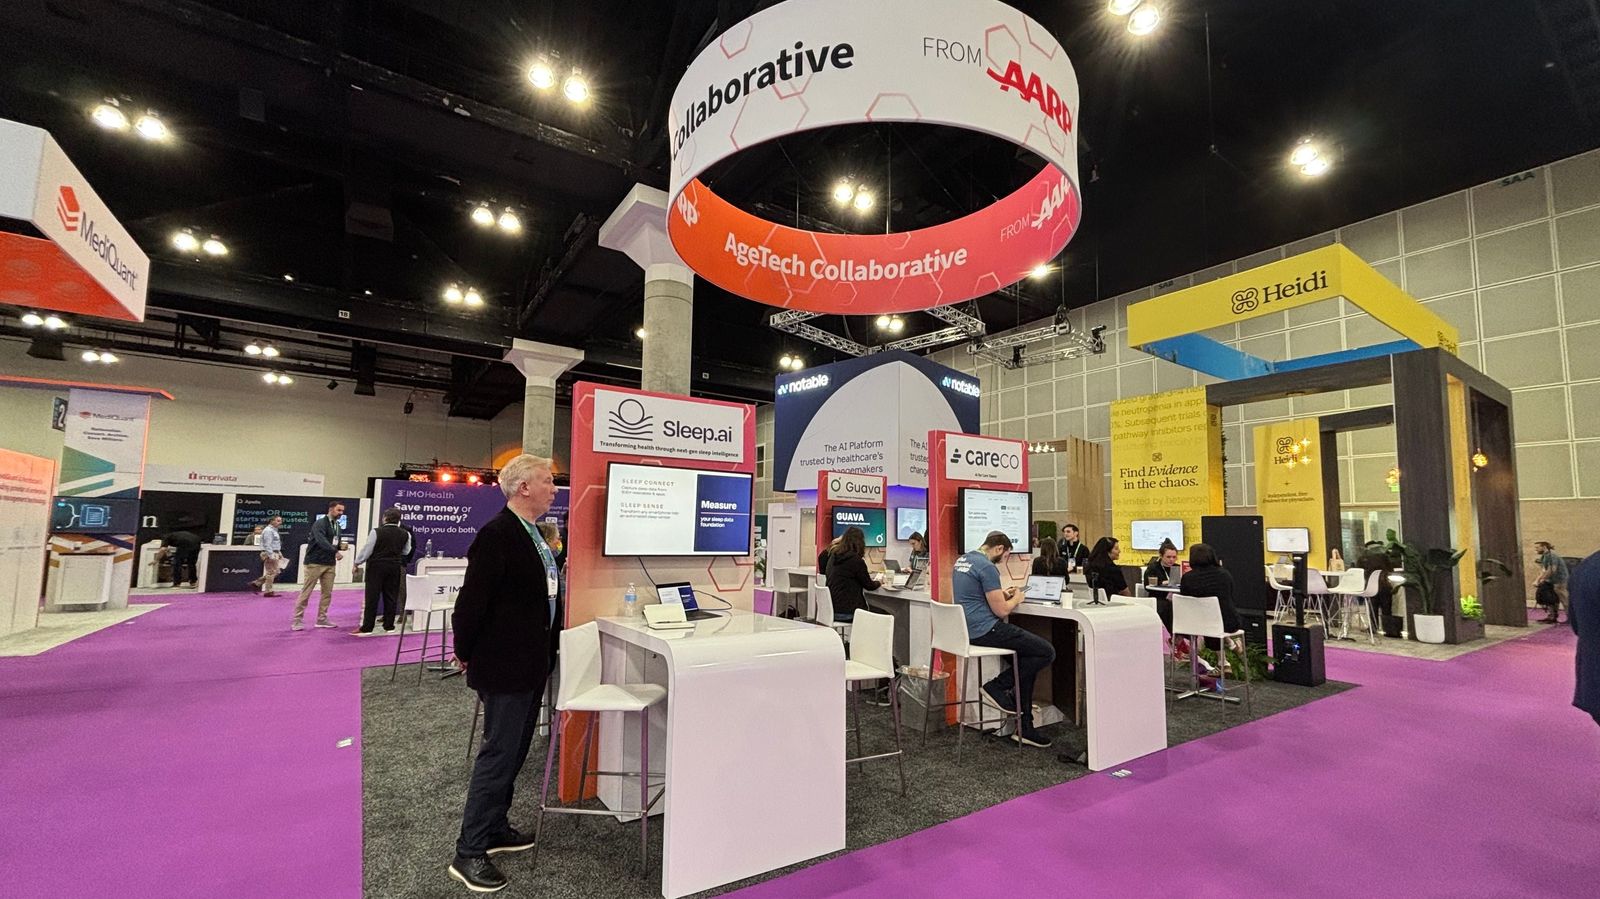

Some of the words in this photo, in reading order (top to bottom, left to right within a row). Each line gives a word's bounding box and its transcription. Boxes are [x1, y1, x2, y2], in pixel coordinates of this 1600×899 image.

[673, 41, 854, 161] Collaborative
[923, 37, 981, 67] FROM
[986, 60, 1072, 135] AARP
[80, 212, 136, 290] MediQuant
[723, 232, 805, 276] AgeTech
[810, 248, 967, 281] Collaborative
[1001, 213, 1030, 242] FROM
[1263, 270, 1328, 304] Heidi
[788, 374, 829, 393] notable
[950, 378, 980, 397] notable
[1124, 414, 1176, 427] Subsequent
[1178, 410, 1200, 420] trials
[663, 420, 732, 443] Sleep.ai
[1113, 431, 1149, 442] pathway
[1151, 424, 1193, 436] inhibitors
[600, 441, 636, 450] Transforming
[712, 450, 739, 458] intelligence
[824, 444, 838, 452] The
[839, 442, 848, 451] AI
[850, 439, 884, 450] Platform
[910, 438, 920, 449] The
[800, 456, 825, 466] trusted
[826, 456, 835, 466] by
[836, 452, 884, 463] healthcare's
[966, 450, 1020, 470] careco
[1274, 454, 1298, 464] Heidi
[198, 474, 238, 482] imprivata
[1120, 466, 1146, 478] Find
[1148, 464, 1198, 476] Evidence
[846, 482, 880, 494] Guava
[1124, 480, 1134, 489] in
[1138, 478, 1156, 488] the
[1159, 476, 1199, 488] chaos.
[394, 502, 421, 512] Save
[423, 504, 460, 514] money
[701, 500, 738, 510] Measure
[426, 514, 468, 524] money?
[836, 512, 864, 522] GUAVA
[412, 526, 430, 534] help
[458, 526, 478, 534] both.
